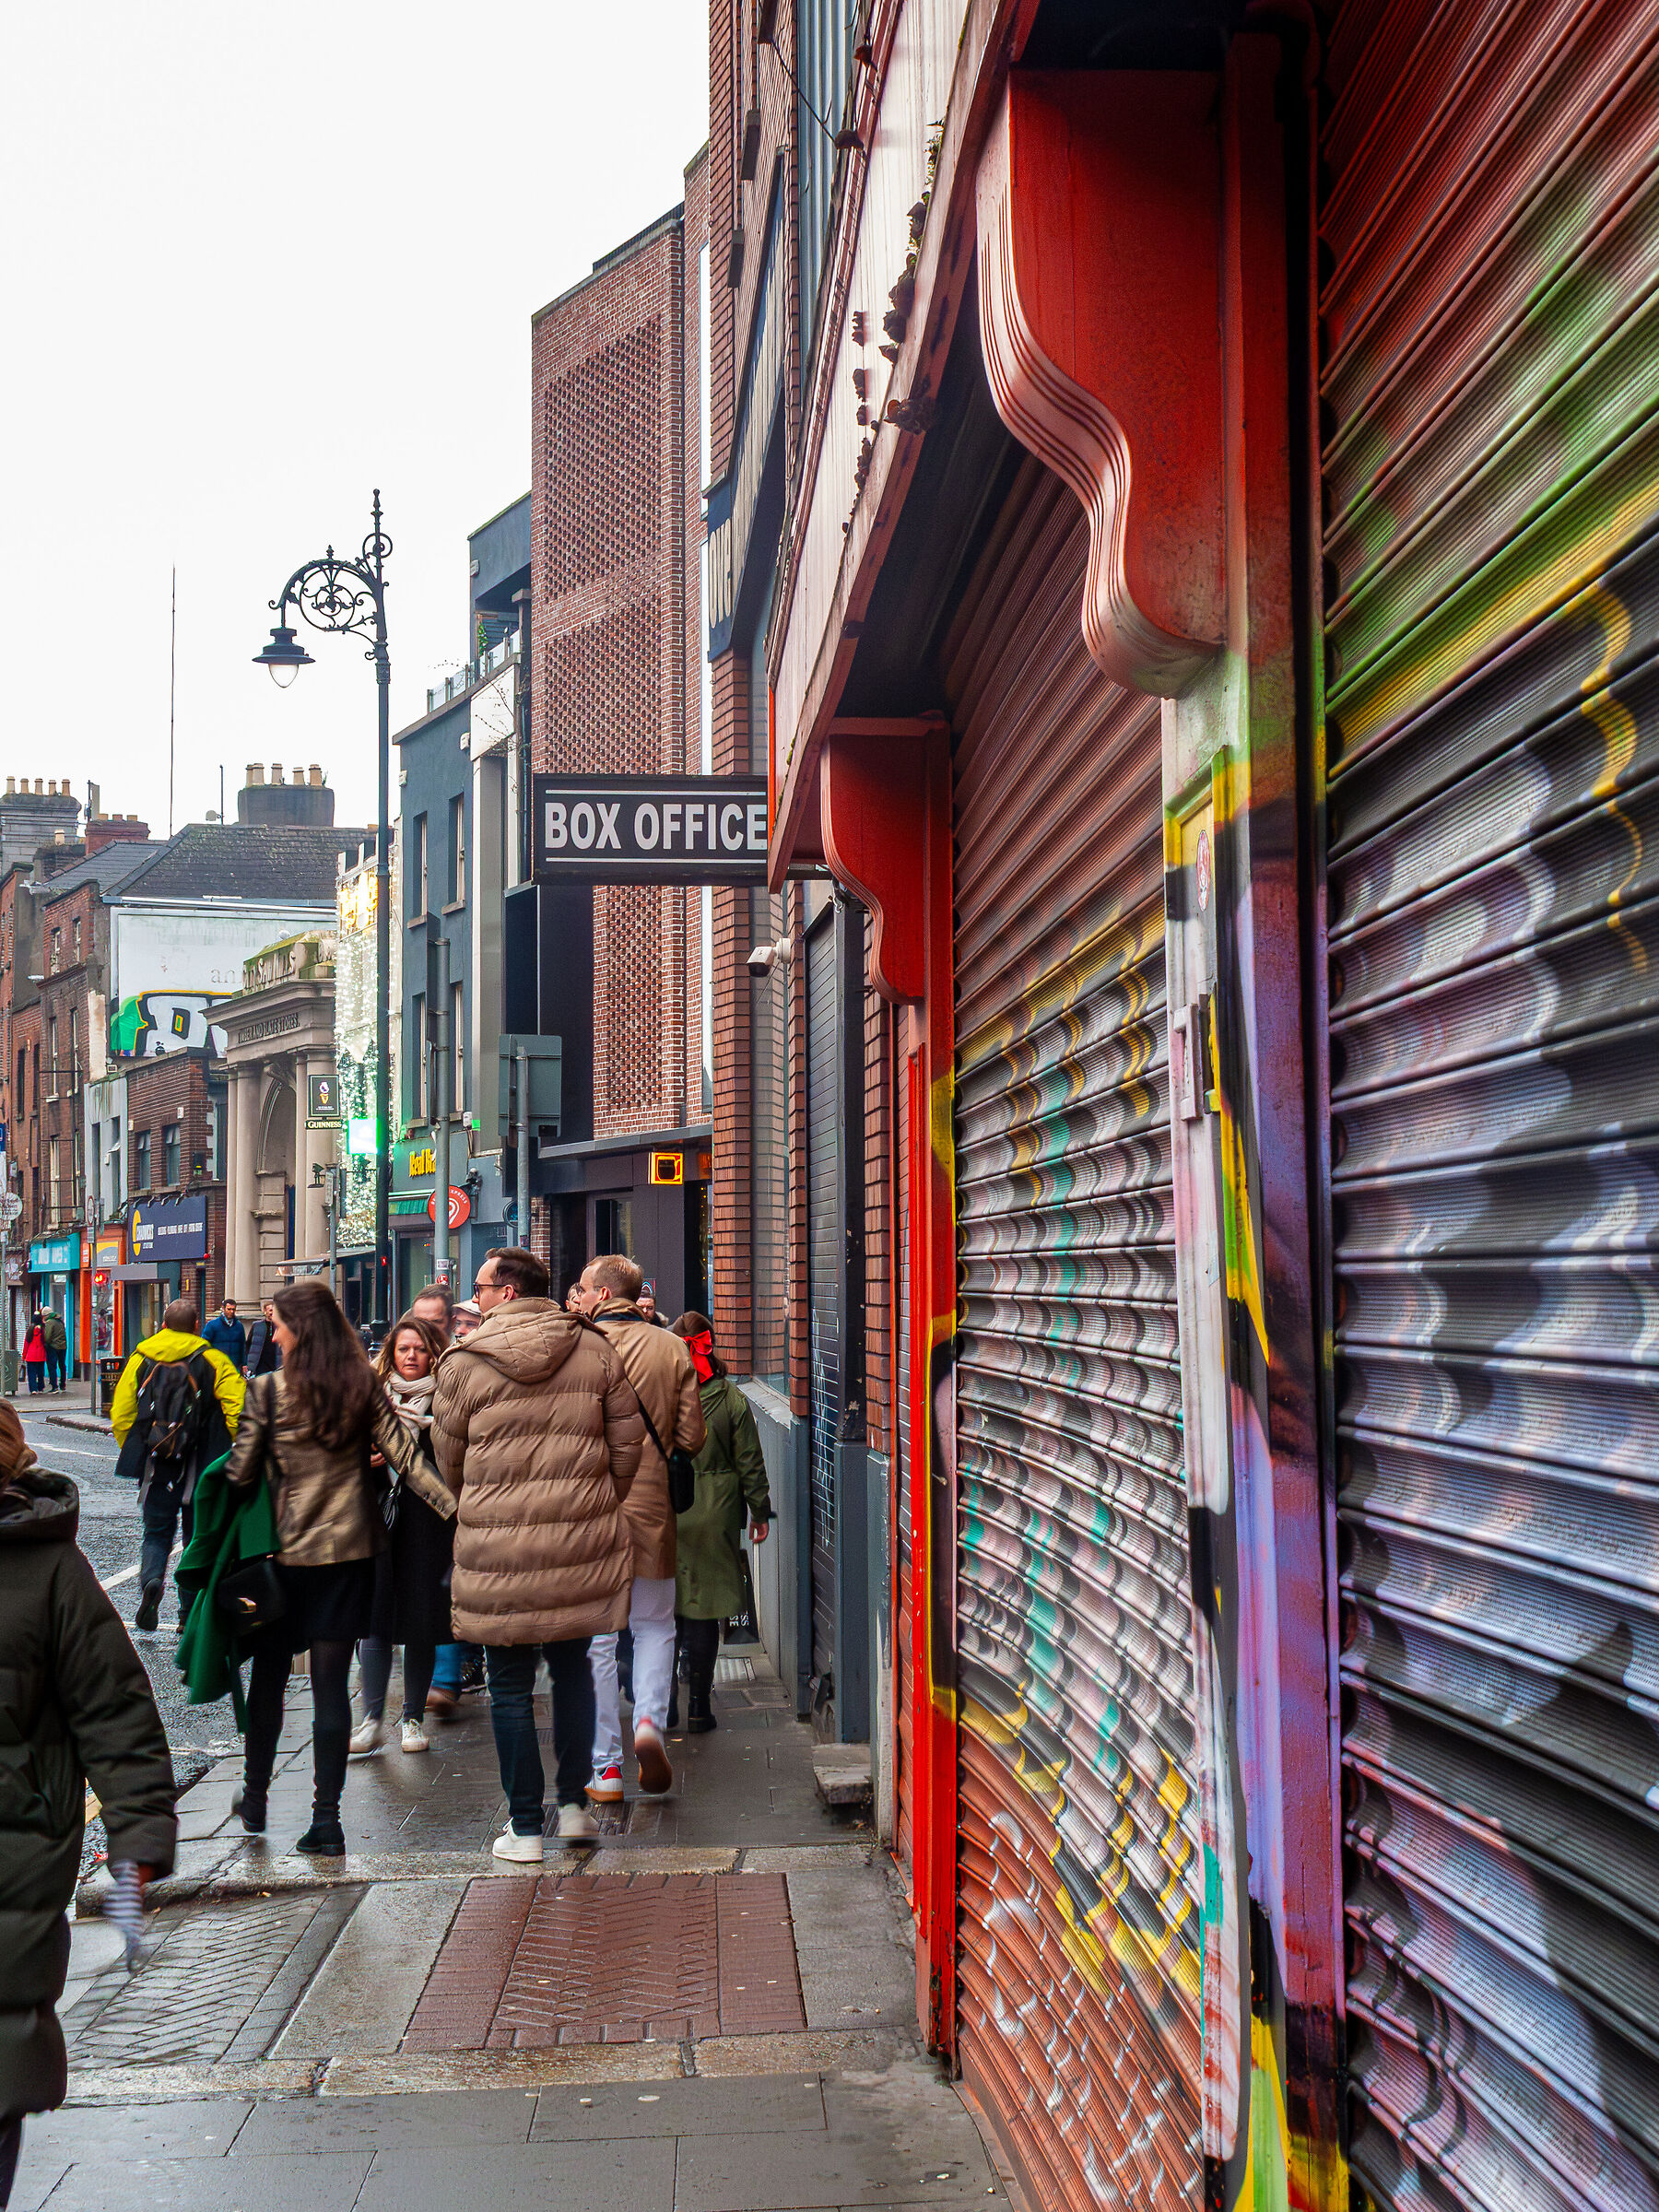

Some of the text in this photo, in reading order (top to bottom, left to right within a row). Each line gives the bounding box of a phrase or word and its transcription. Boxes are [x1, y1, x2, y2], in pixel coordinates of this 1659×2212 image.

[545, 802, 768, 851] BOX OFFICE
[307, 1121, 342, 1129] GUINNESS
